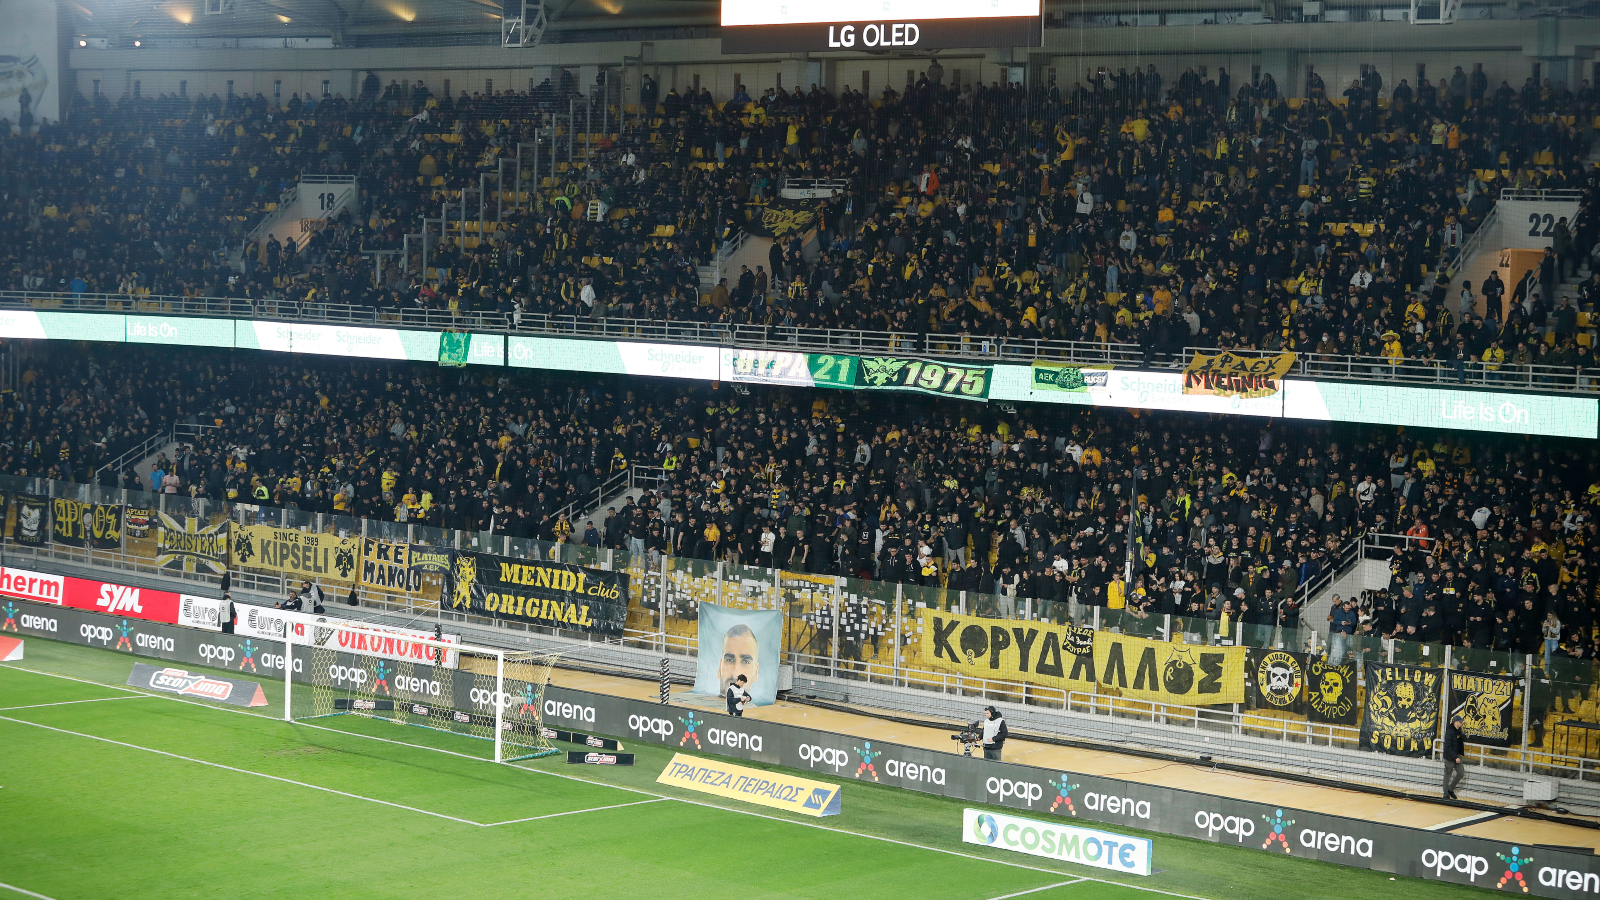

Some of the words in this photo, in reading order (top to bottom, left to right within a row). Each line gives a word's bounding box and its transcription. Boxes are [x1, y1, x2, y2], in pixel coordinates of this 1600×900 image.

[828, 25, 855, 47] LG
[863, 23, 920, 47] OLED
[318, 192, 335, 210] 18
[1528, 213, 1555, 237] 22
[1499, 253, 1510, 267] 22
[126, 322, 147, 336] Life
[149, 323, 158, 337] Is
[160, 321, 178, 337] On
[336, 330, 382, 345] Schneider
[474, 341, 494, 357] Life
[514, 342, 533, 360] On
[647, 348, 704, 365] Schneider
[813, 354, 851, 382] 21
[904, 360, 987, 396] 1975
[1038, 372, 1055, 382] AEK
[1441, 399, 1475, 421] Life
[1479, 402, 1495, 422] Is
[1500, 401, 1529, 424] On
[163, 525, 220, 559] PERISTERI
[273, 531, 299, 543] SINCE
[303, 536, 319, 547] 1989
[363, 537, 410, 566] FRE
[260, 538, 329, 574] KIPSELI
[0, 567, 59, 598] herm
[500, 562, 587, 594] MENIDI
[587, 581, 620, 600] club
[96, 583, 143, 613] SYM
[485, 592, 593, 627] ORIGINAL
[20, 613, 58, 633] arena
[80, 623, 113, 646] opap
[136, 632, 175, 652] arena
[198, 643, 235, 667] opap
[1259, 661, 1269, 675] ANO
[1268, 653, 1290, 663] LIOSIA
[329, 664, 368, 688] opap
[394, 674, 441, 696] arena
[1312, 660, 1354, 683] ORIGINAL
[1374, 667, 1437, 687] YELLOW
[1453, 673, 1493, 695] KIATO
[1493, 679, 1513, 696] 21
[544, 699, 596, 723] arena
[1308, 691, 1354, 719] ALEXIPOLI
[628, 714, 674, 742] opap
[707, 727, 763, 752] arena
[1370, 730, 1433, 752] SQUAD
[798, 743, 849, 773] opap
[885, 758, 946, 786] arena
[668, 762, 732, 789] ΤΡΑΠΕΖΑ
[732, 775, 805, 803] ΠΕΙΡΑΙΩΣ
[986, 776, 1043, 807] opap
[1083, 791, 1152, 820] arena
[1002, 823, 1136, 869] COSMOTE
[1194, 810, 1255, 843] opap
[1299, 828, 1373, 859] arena
[1421, 848, 1489, 883] opap
[1538, 866, 1600, 894] aren
